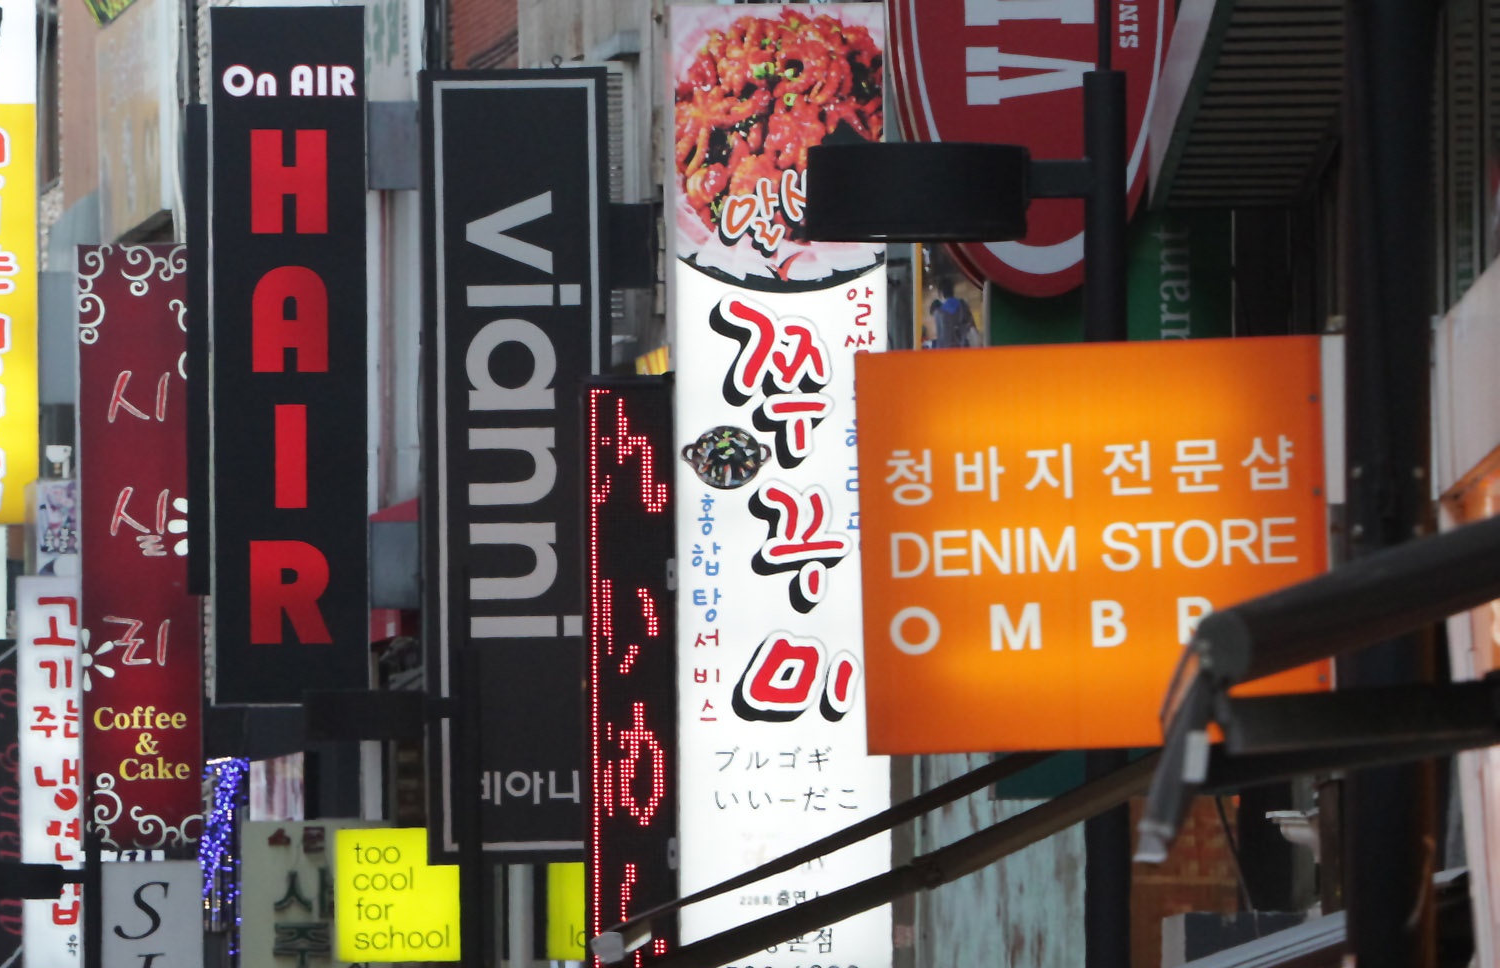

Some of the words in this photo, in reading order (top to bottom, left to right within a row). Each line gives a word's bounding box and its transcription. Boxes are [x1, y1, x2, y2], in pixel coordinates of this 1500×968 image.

[222, 63, 278, 97] On
[290, 63, 357, 97] AIR
[249, 128, 333, 646] HAIR
[464, 189, 584, 639] Vianni
[889, 525, 1077, 580] DENIM
[1101, 516, 1299, 572] STORE
[93, 705, 189, 732] Coffee
[134, 733, 160, 756] &
[118, 756, 191, 781] Cake
[714, 746, 833, 772] ブルゴギ
[353, 841, 401, 865] too
[352, 866, 414, 892] cool
[355, 898, 395, 922] for
[353, 924, 451, 952] school
